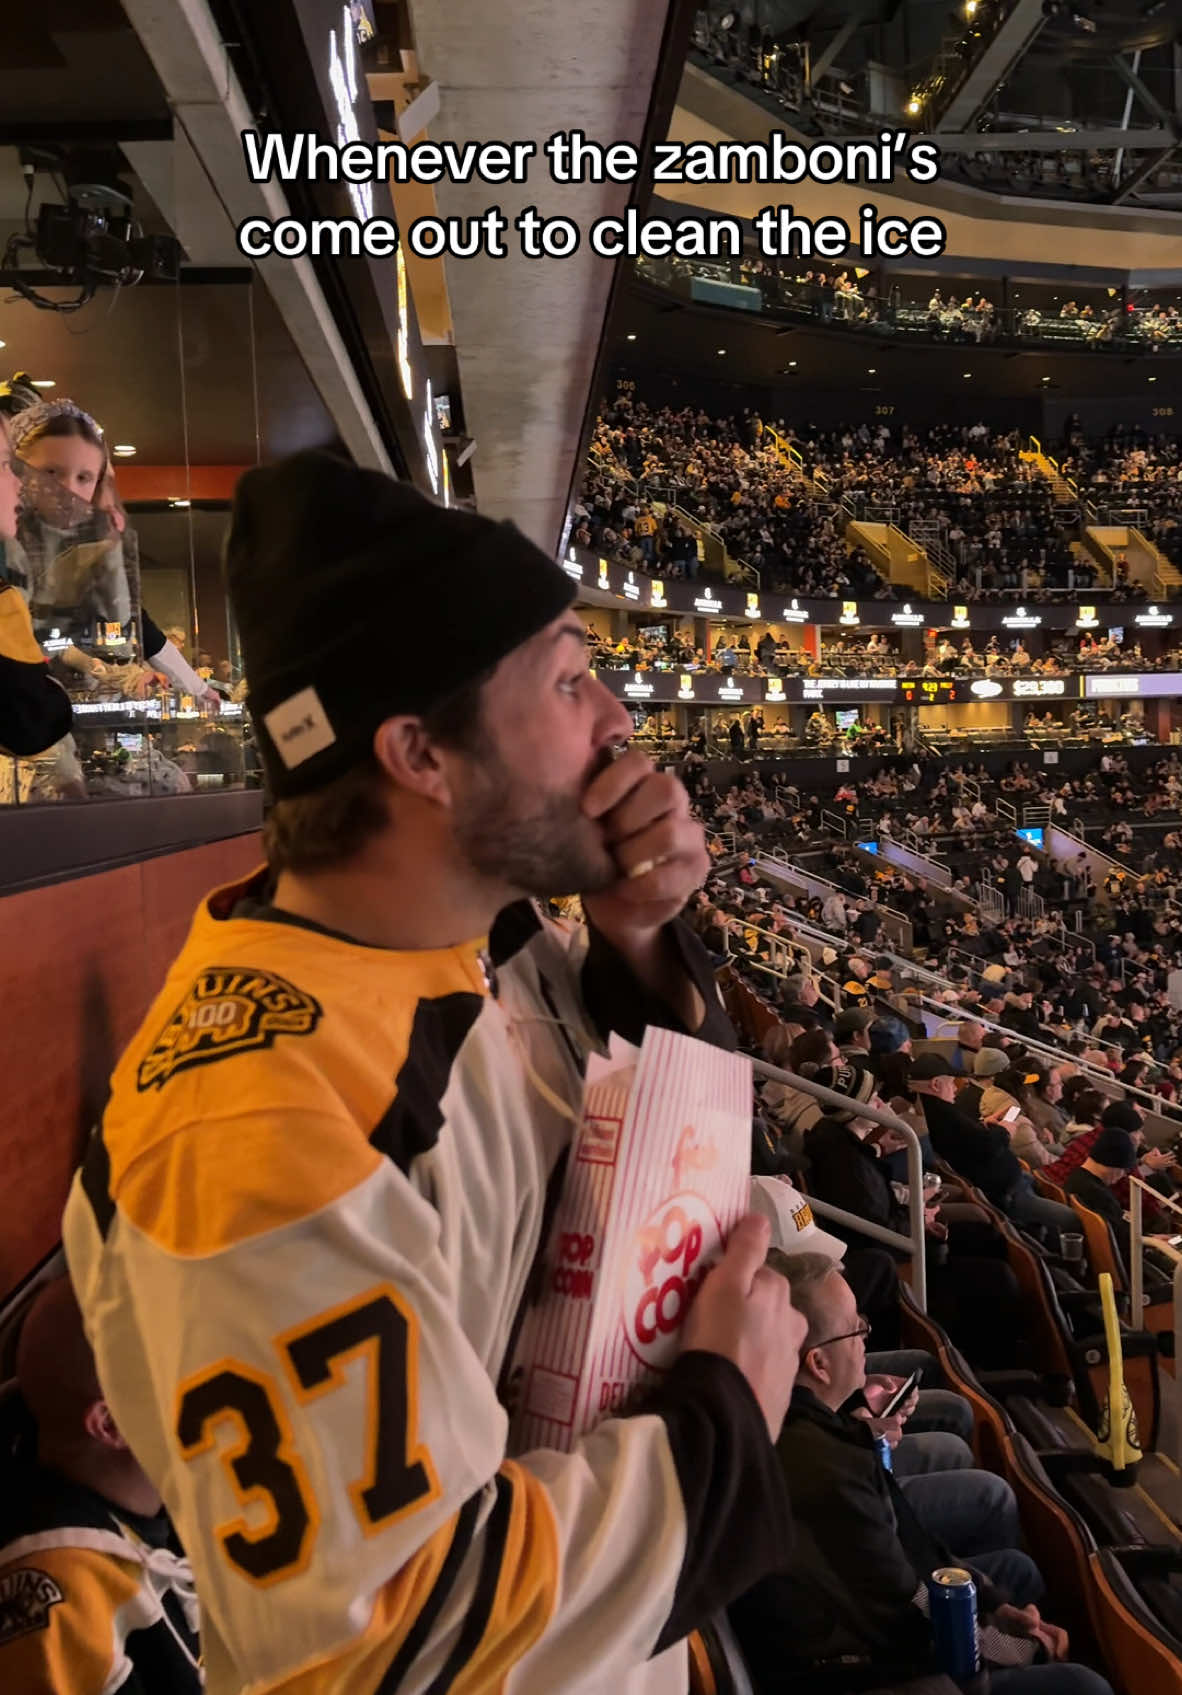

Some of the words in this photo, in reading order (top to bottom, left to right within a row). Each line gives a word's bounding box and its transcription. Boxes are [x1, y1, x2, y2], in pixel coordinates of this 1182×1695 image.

[874, 405, 895, 416] 307
[196, 975, 302, 1012] UINS
[188, 1001, 237, 1029] 100
[175, 1280, 443, 1590] 37
